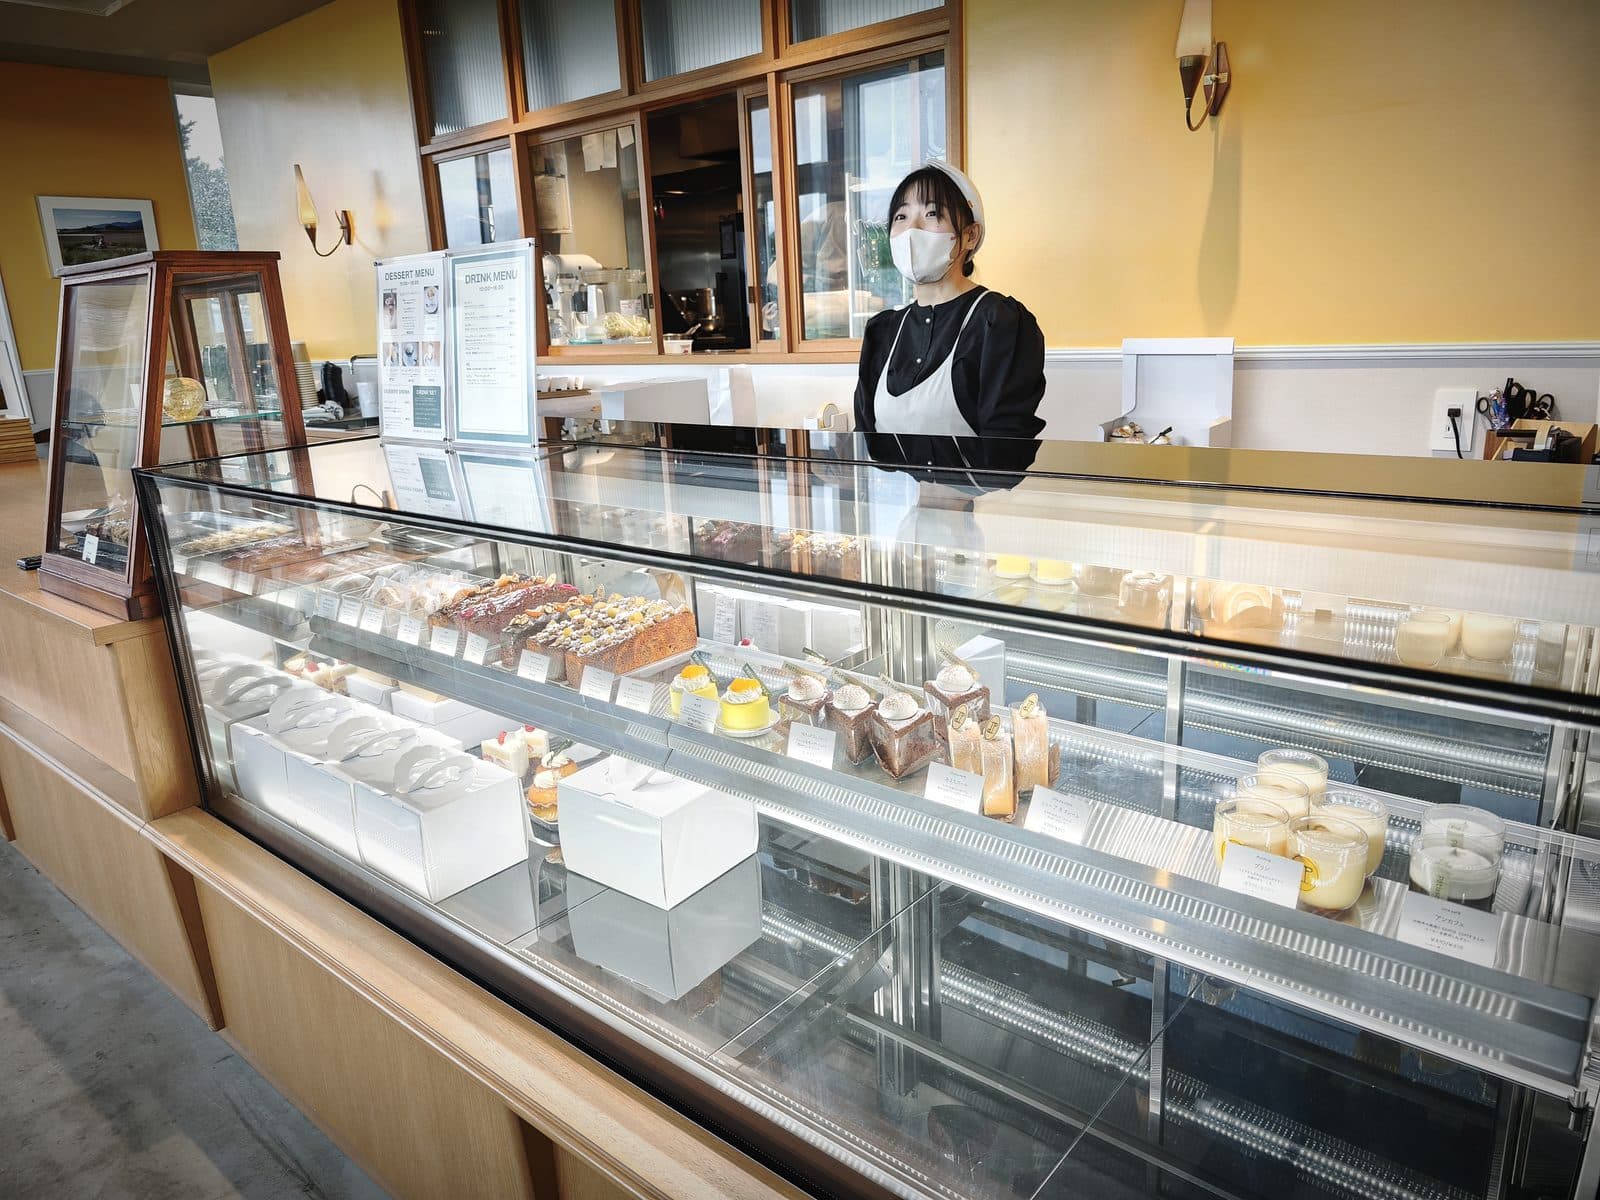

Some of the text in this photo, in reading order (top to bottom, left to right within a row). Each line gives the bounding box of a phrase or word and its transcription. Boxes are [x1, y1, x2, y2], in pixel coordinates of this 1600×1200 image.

[384, 267, 435, 281] DESSERT MENU
[465, 269, 518, 285] DRINK MENU
